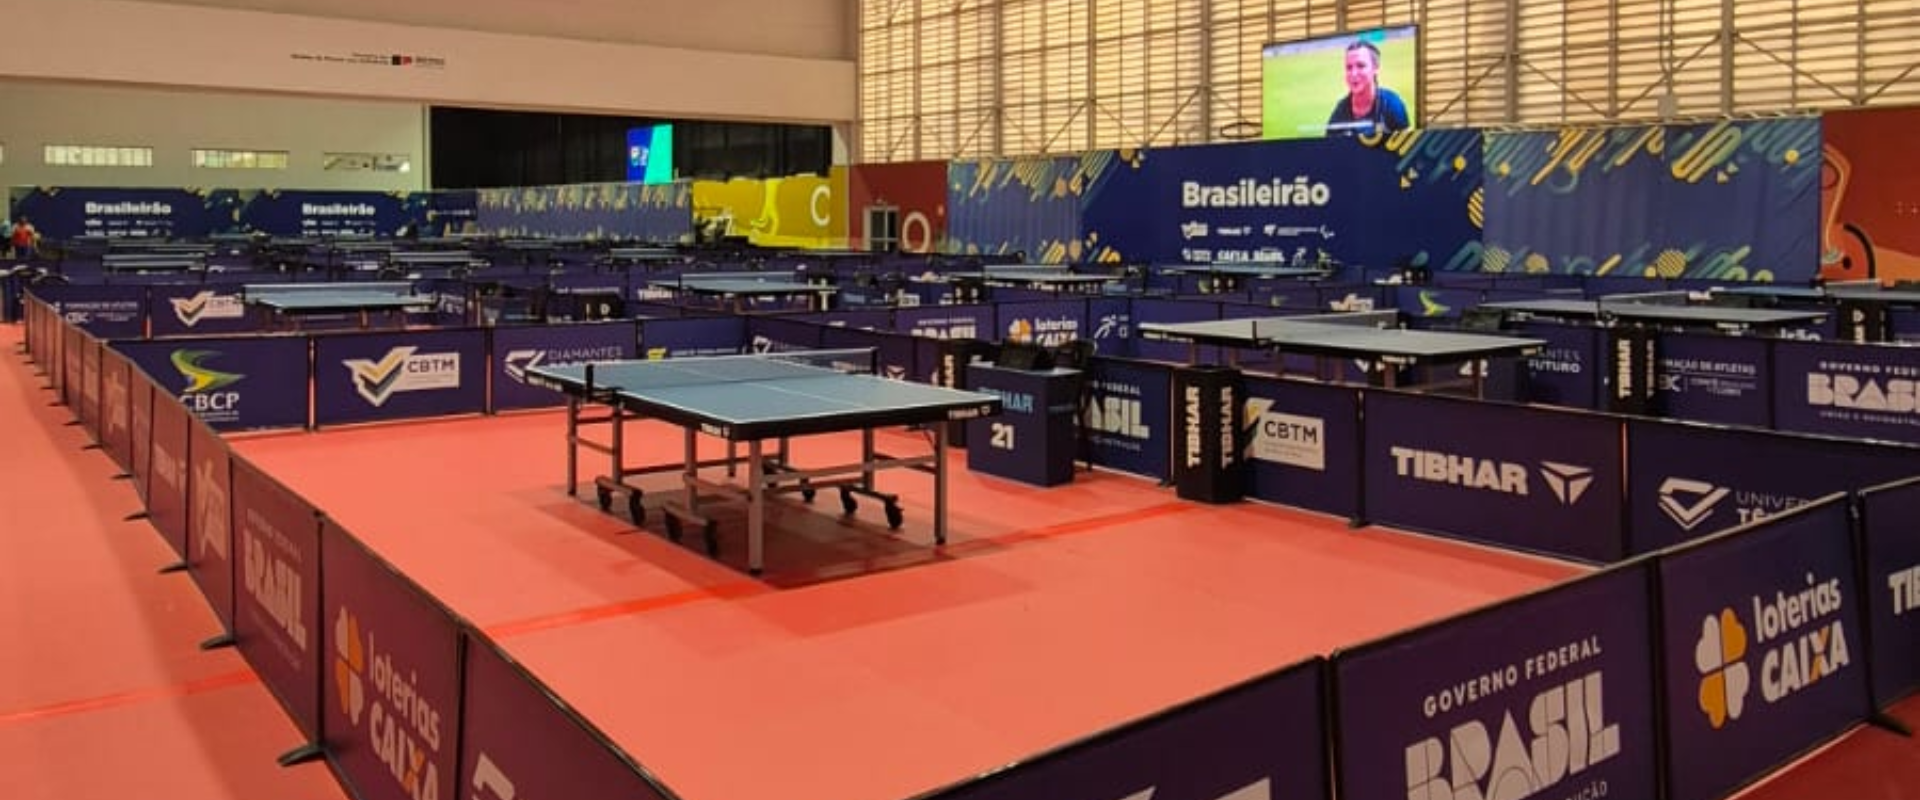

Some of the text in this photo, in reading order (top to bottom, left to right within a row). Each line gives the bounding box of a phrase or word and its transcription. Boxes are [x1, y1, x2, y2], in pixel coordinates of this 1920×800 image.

[85, 201, 171, 214] Brasileirão
[302, 203, 375, 215] Brasileirão
[1182, 176, 1330, 207] Brasileirão
[407, 359, 455, 373] CBTM
[549, 347, 623, 360] DIAMANTES
[991, 423, 1014, 449] 21
[1186, 386, 1201, 468] TIBHAR
[1220, 386, 1235, 469] TIBHAR
[1264, 420, 1317, 444] CBTM
[1390, 447, 1528, 495] TIBHAR
[243, 528, 306, 651] BRASIL
[1753, 572, 1843, 644] loterias
[369, 631, 440, 752] loterias
[1424, 635, 1602, 718] GOVERNO FEDERAL
[1761, 620, 1850, 703] CAIXA
[370, 702, 439, 800] CAIXA
[1405, 670, 1621, 800] BRASIL
